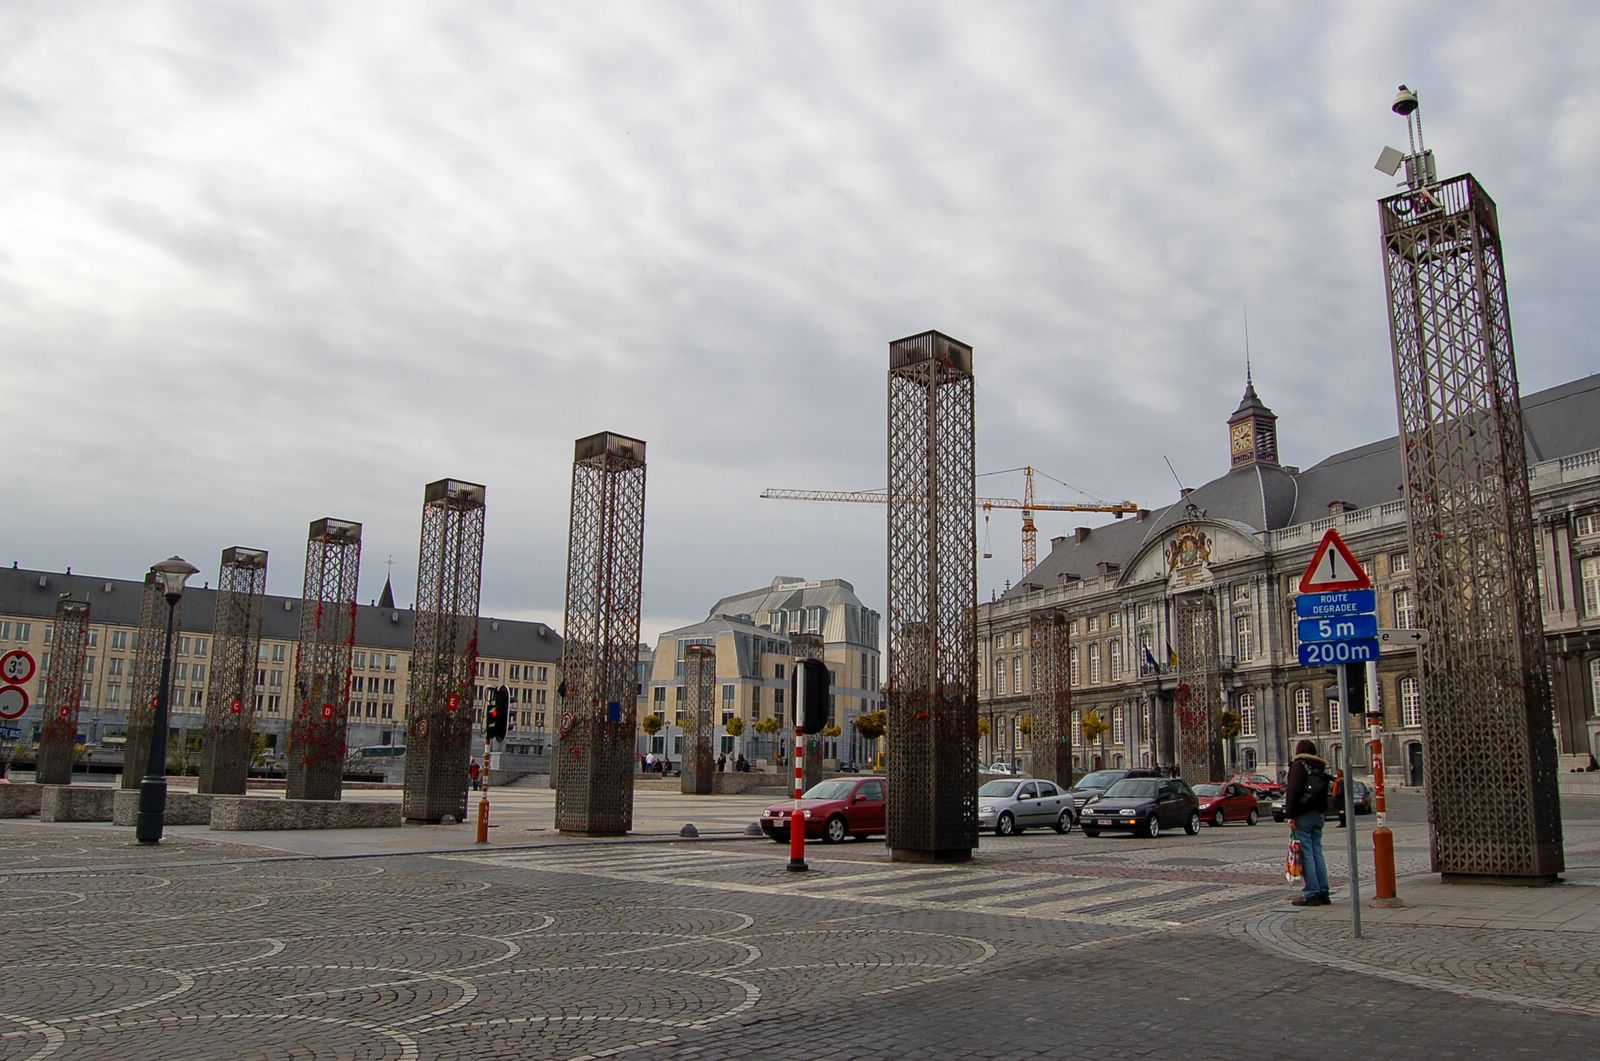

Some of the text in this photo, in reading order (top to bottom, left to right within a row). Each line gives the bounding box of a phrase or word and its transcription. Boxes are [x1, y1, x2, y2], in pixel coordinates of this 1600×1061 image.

[1320, 593, 1348, 603] ROUTE
[1319, 620, 1355, 638] 5 m
[1307, 643, 1370, 663] 200m
